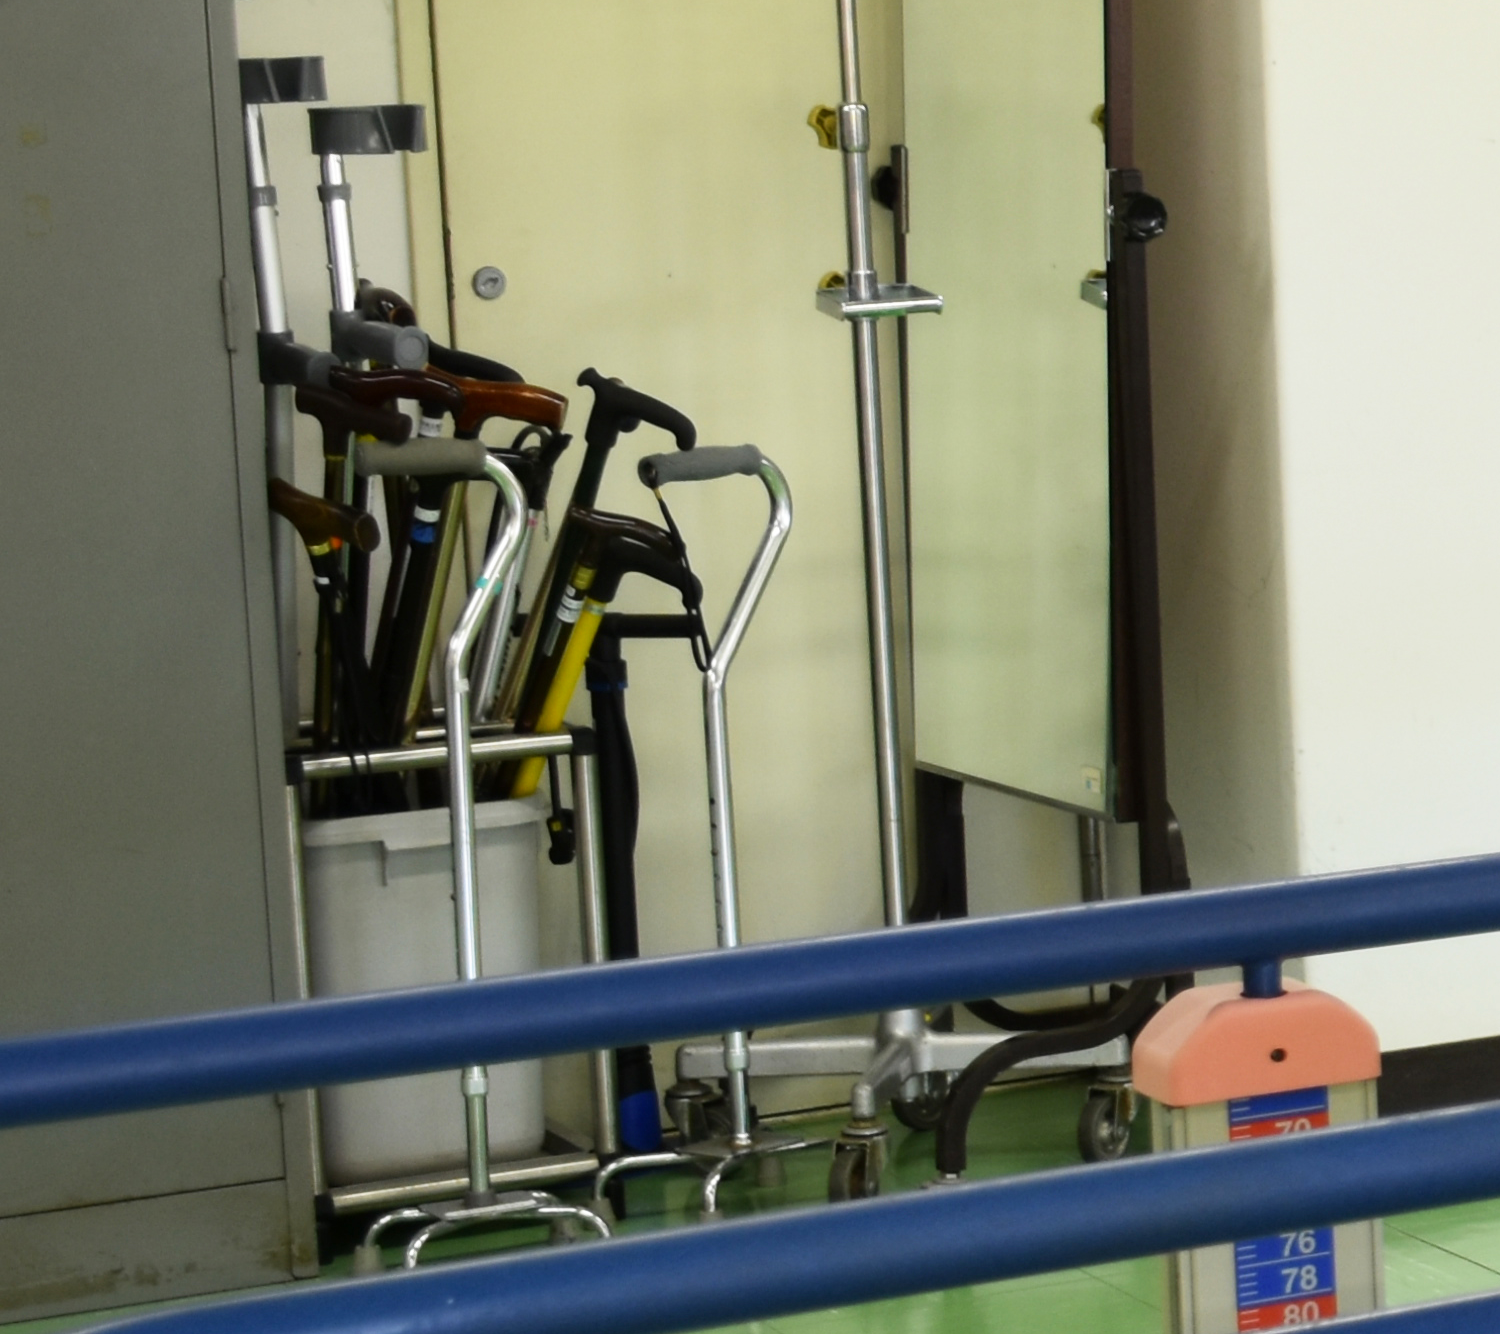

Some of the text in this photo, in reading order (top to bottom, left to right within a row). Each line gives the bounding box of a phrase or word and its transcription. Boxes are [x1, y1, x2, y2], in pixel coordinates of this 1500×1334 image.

[1280, 1229, 1317, 1257] 76
[1281, 1264, 1318, 1294] 78
[1283, 1300, 1320, 1326] 80
